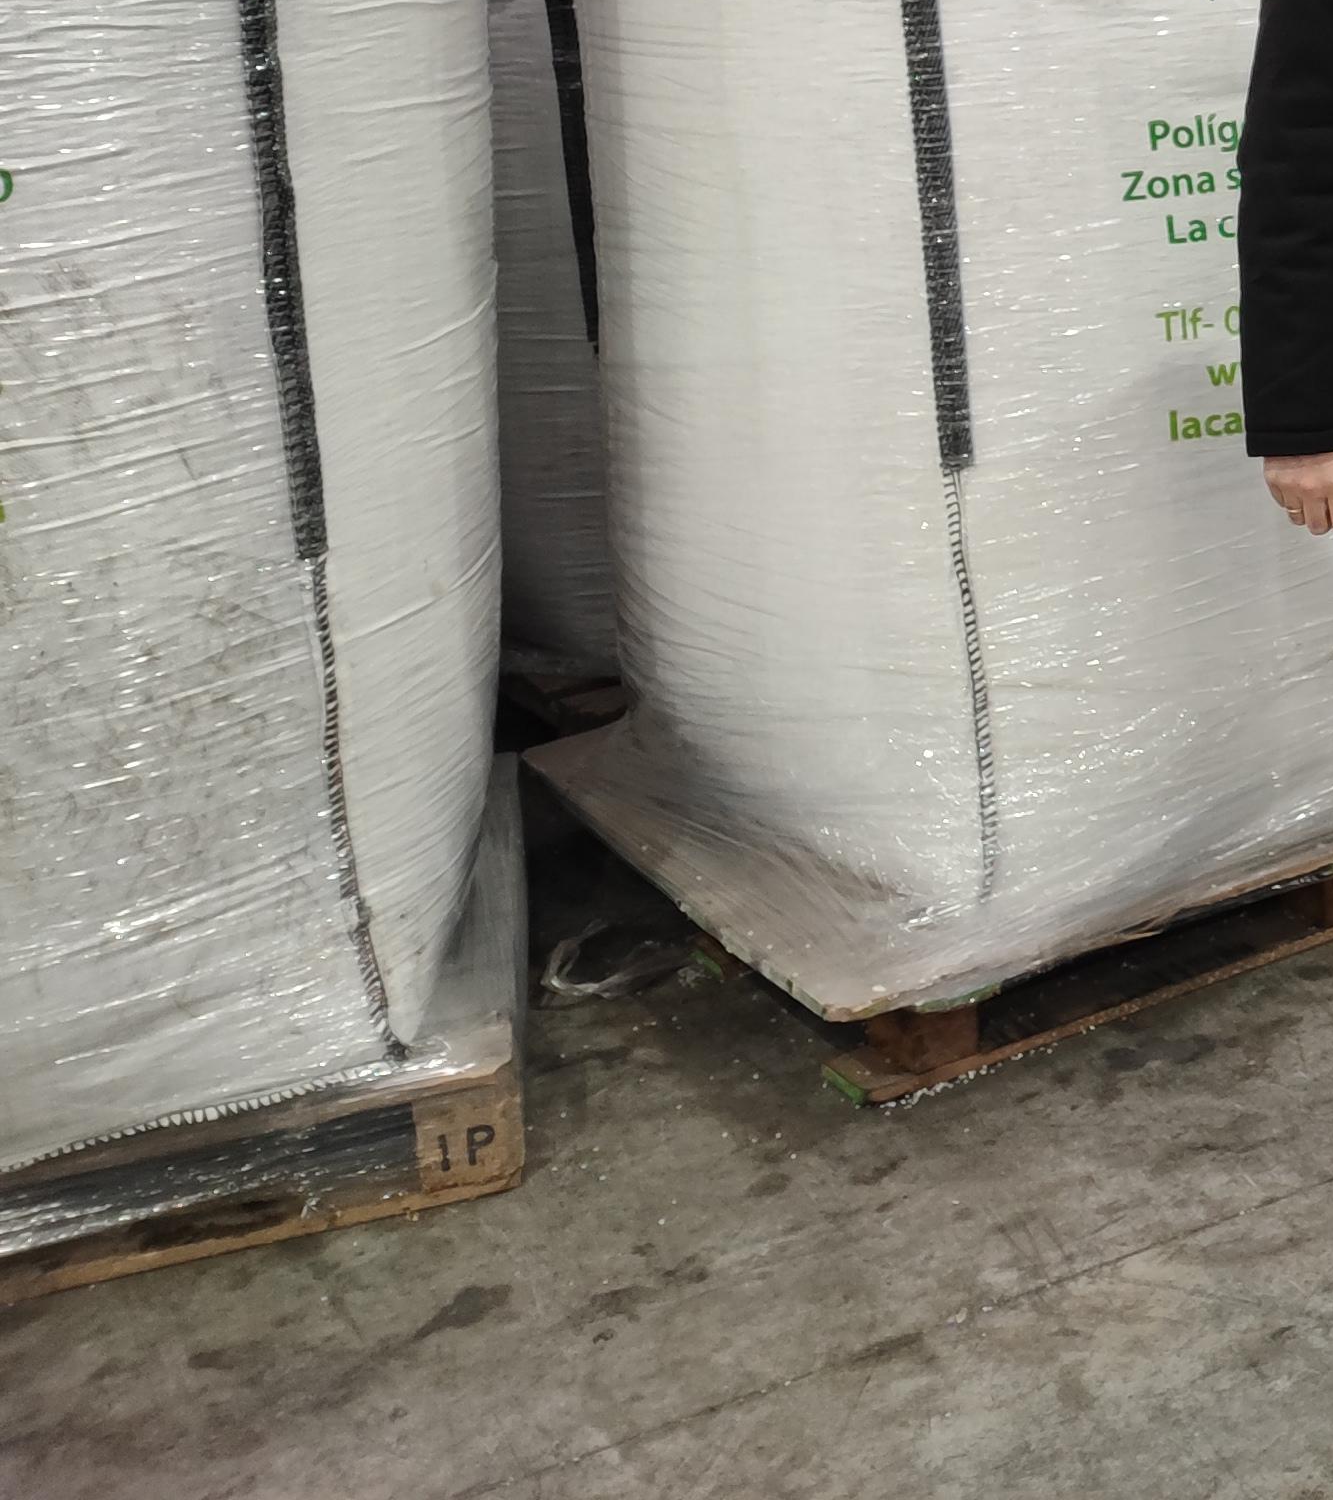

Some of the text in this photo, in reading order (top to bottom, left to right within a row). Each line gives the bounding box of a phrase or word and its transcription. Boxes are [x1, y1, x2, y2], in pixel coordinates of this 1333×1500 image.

[1148, 113, 1239, 153] Políg
[1120, 170, 1216, 202] Zona
[1165, 214, 1208, 244] La
